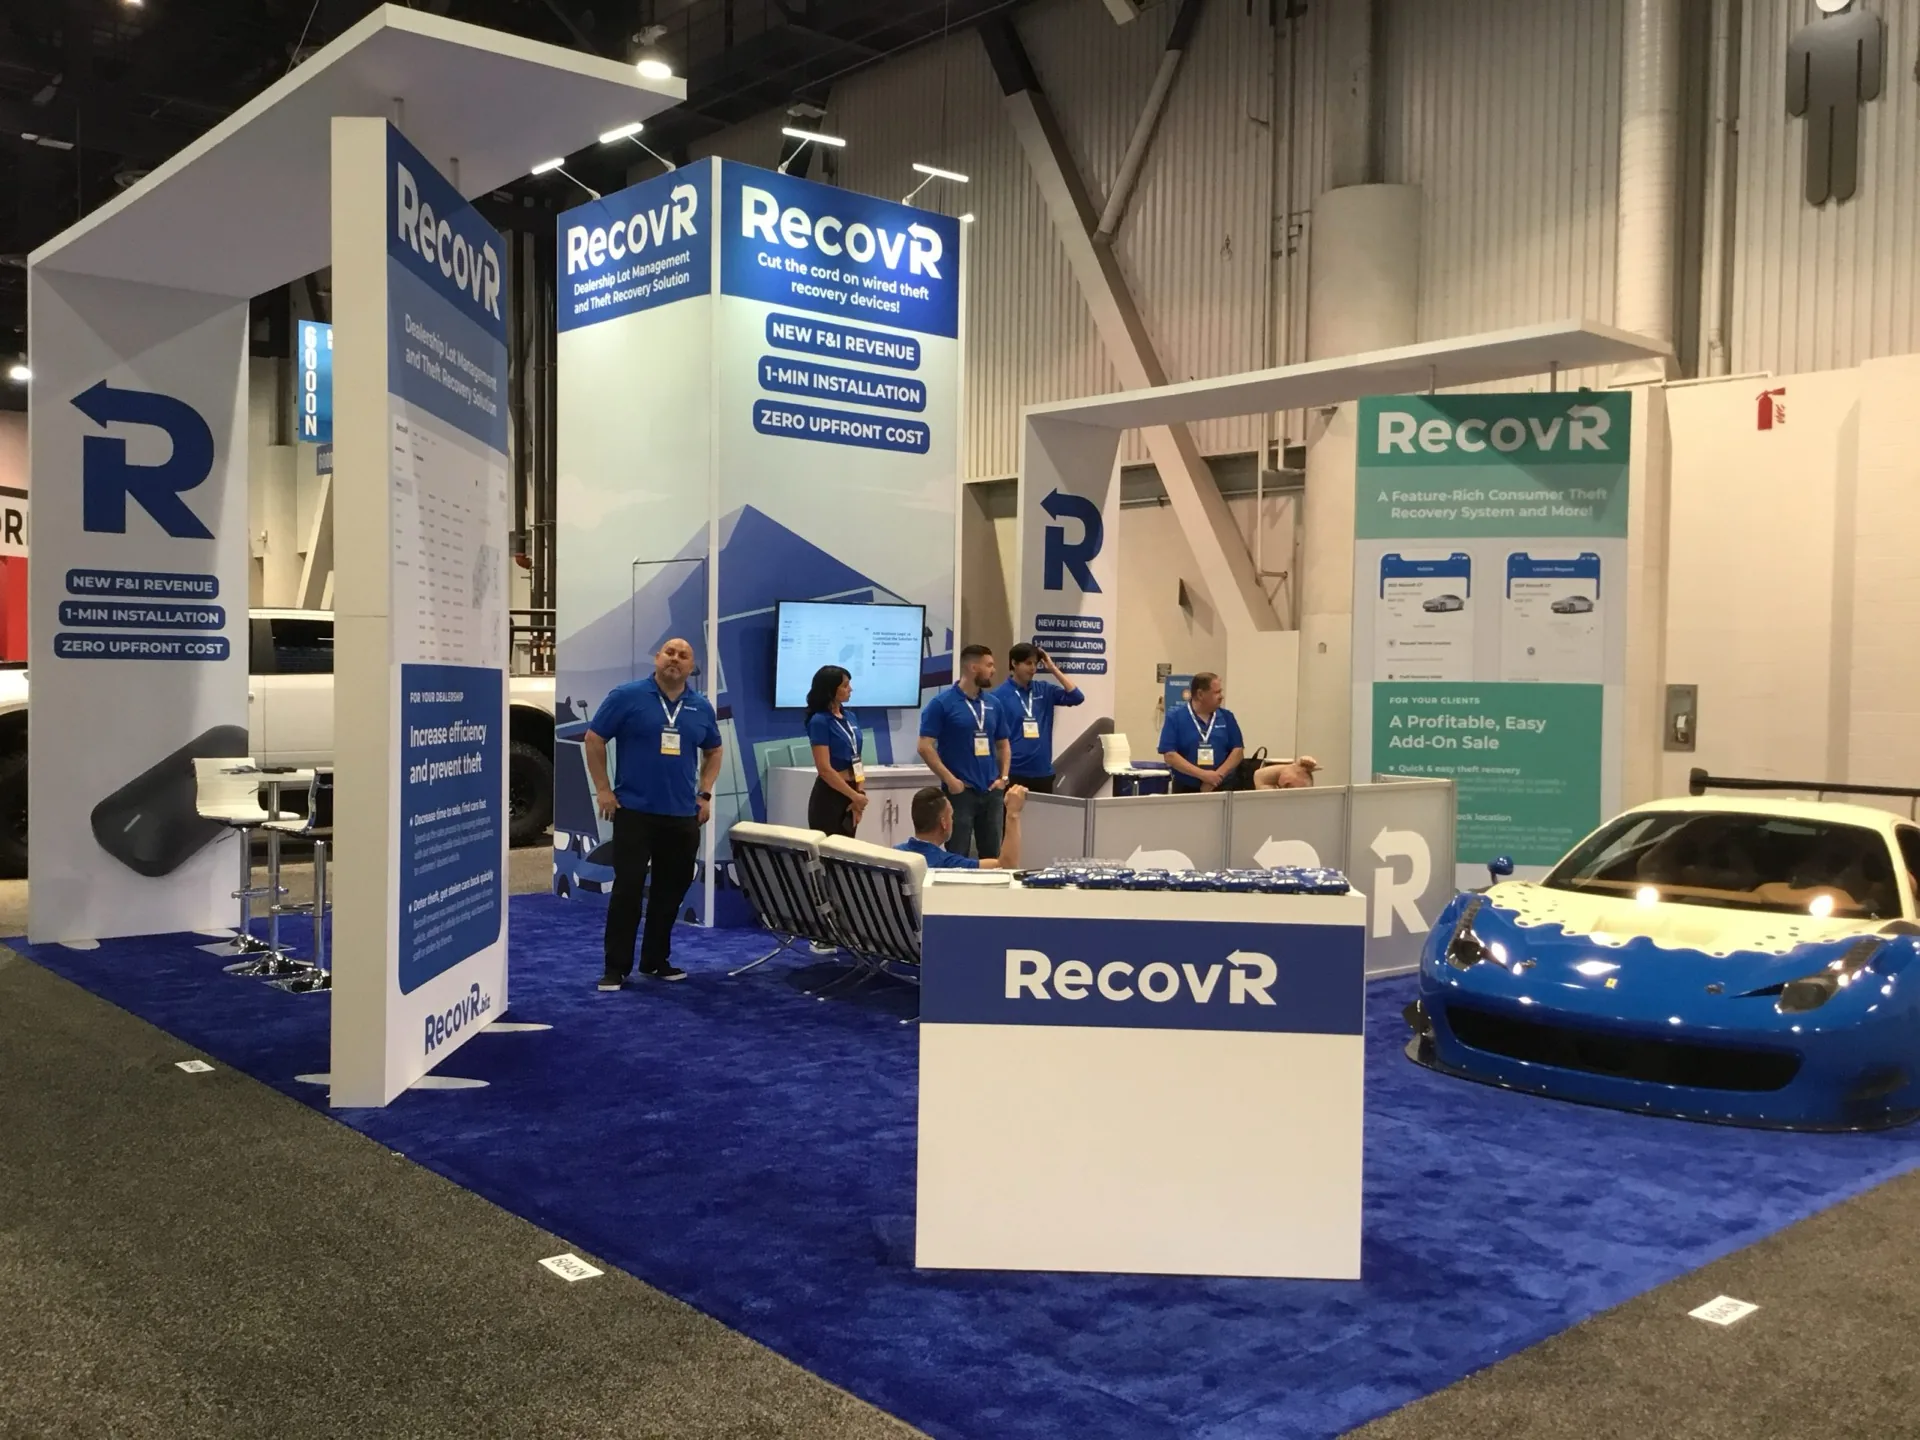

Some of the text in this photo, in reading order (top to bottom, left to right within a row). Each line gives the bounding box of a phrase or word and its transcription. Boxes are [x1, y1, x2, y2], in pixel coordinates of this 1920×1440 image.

[398, 161, 501, 321] RecovR
[567, 183, 698, 275] RecovR
[741, 185, 942, 279] RecovR
[574, 250, 690, 296] Dealership Lot Management
[757, 252, 929, 300] Cut the cord on wired theft
[574, 272, 690, 314] and Theft Recovery Solution
[791, 281, 900, 314] recovery devices!
[405, 313, 497, 393] Dealership Lot Management
[773, 322, 915, 362] NEW F&I REVENUE
[405, 347, 497, 418] and Theft Recovery Solution
[765, 366, 921, 404] 1-MIN INSTALLATION
[761, 409, 924, 446] ZERO UPFRONT COST
[1378, 404, 1611, 454] RecovR
[1377, 488, 1608, 503] A Feature-Rich Consumer Theft
[1391, 505, 1593, 521] Recovery System and More!
[72, 575, 213, 593] NEW F&I REVENUE
[65, 608, 219, 624] 1-MIN INSTALLATION
[1038, 618, 1101, 630] NEW F&I REVENUE
[62, 640, 224, 655] ZERO UPFRONT COST
[1034, 639, 1103, 650] 1-MIN INSTALLATION
[1086, 661, 1105, 671] COST
[410, 691, 464, 703] FOR YOUR DEALERSHIP
[410, 719, 487, 748] Increase efficiency
[1389, 715, 1547, 733] A Profitable, Easy
[1389, 735, 1500, 749] Add-On Sale
[410, 751, 482, 786] and prevent theft
[1398, 765, 1521, 776] Quick & easy theft recovery
[1475, 813, 1512, 822] location
[1005, 948, 1278, 1006] RecovR
